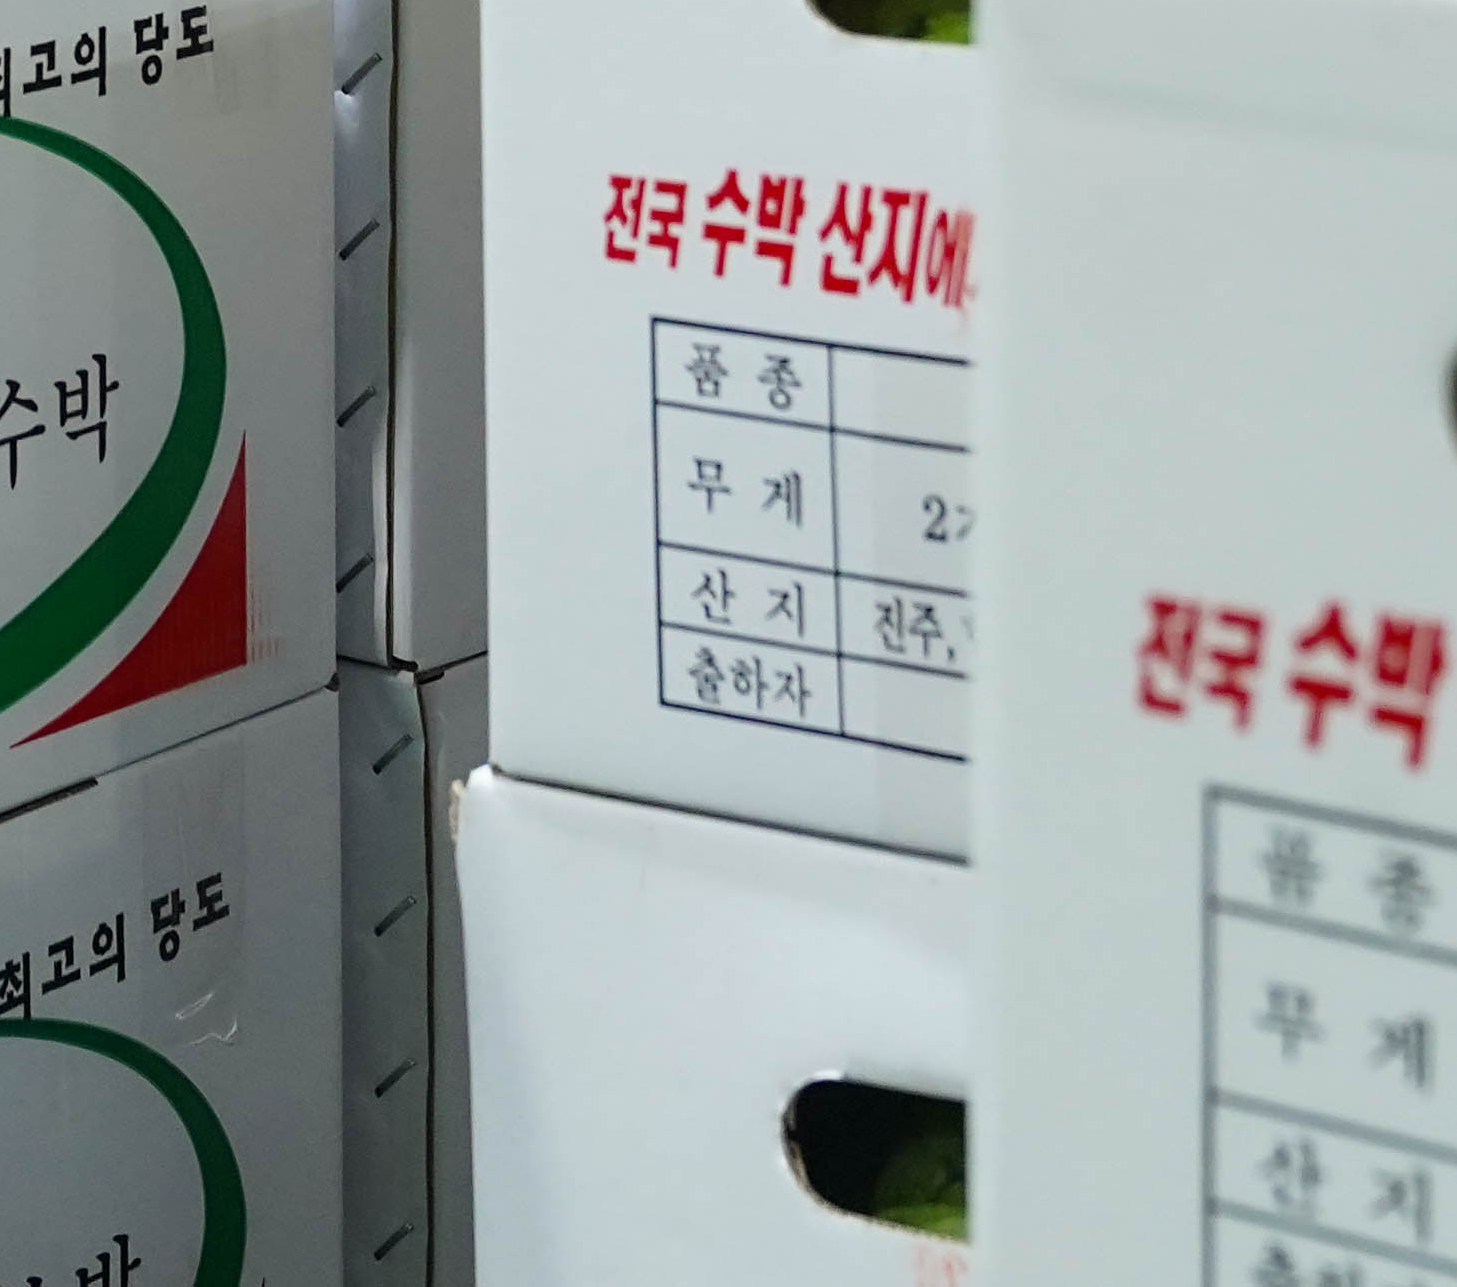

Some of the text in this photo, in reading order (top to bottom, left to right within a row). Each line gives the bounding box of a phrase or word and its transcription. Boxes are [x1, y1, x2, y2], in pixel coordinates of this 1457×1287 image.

[133, 4, 215, 86] 당도
[603, 168, 975, 310] 전국 수박 산지에
[875, 595, 974, 662] 진주,
[687, 647, 812, 718] 출하자
[1137, 592, 1264, 730] 전국
[1289, 601, 1446, 770] 수박
[151, 872, 231, 962] 당도
